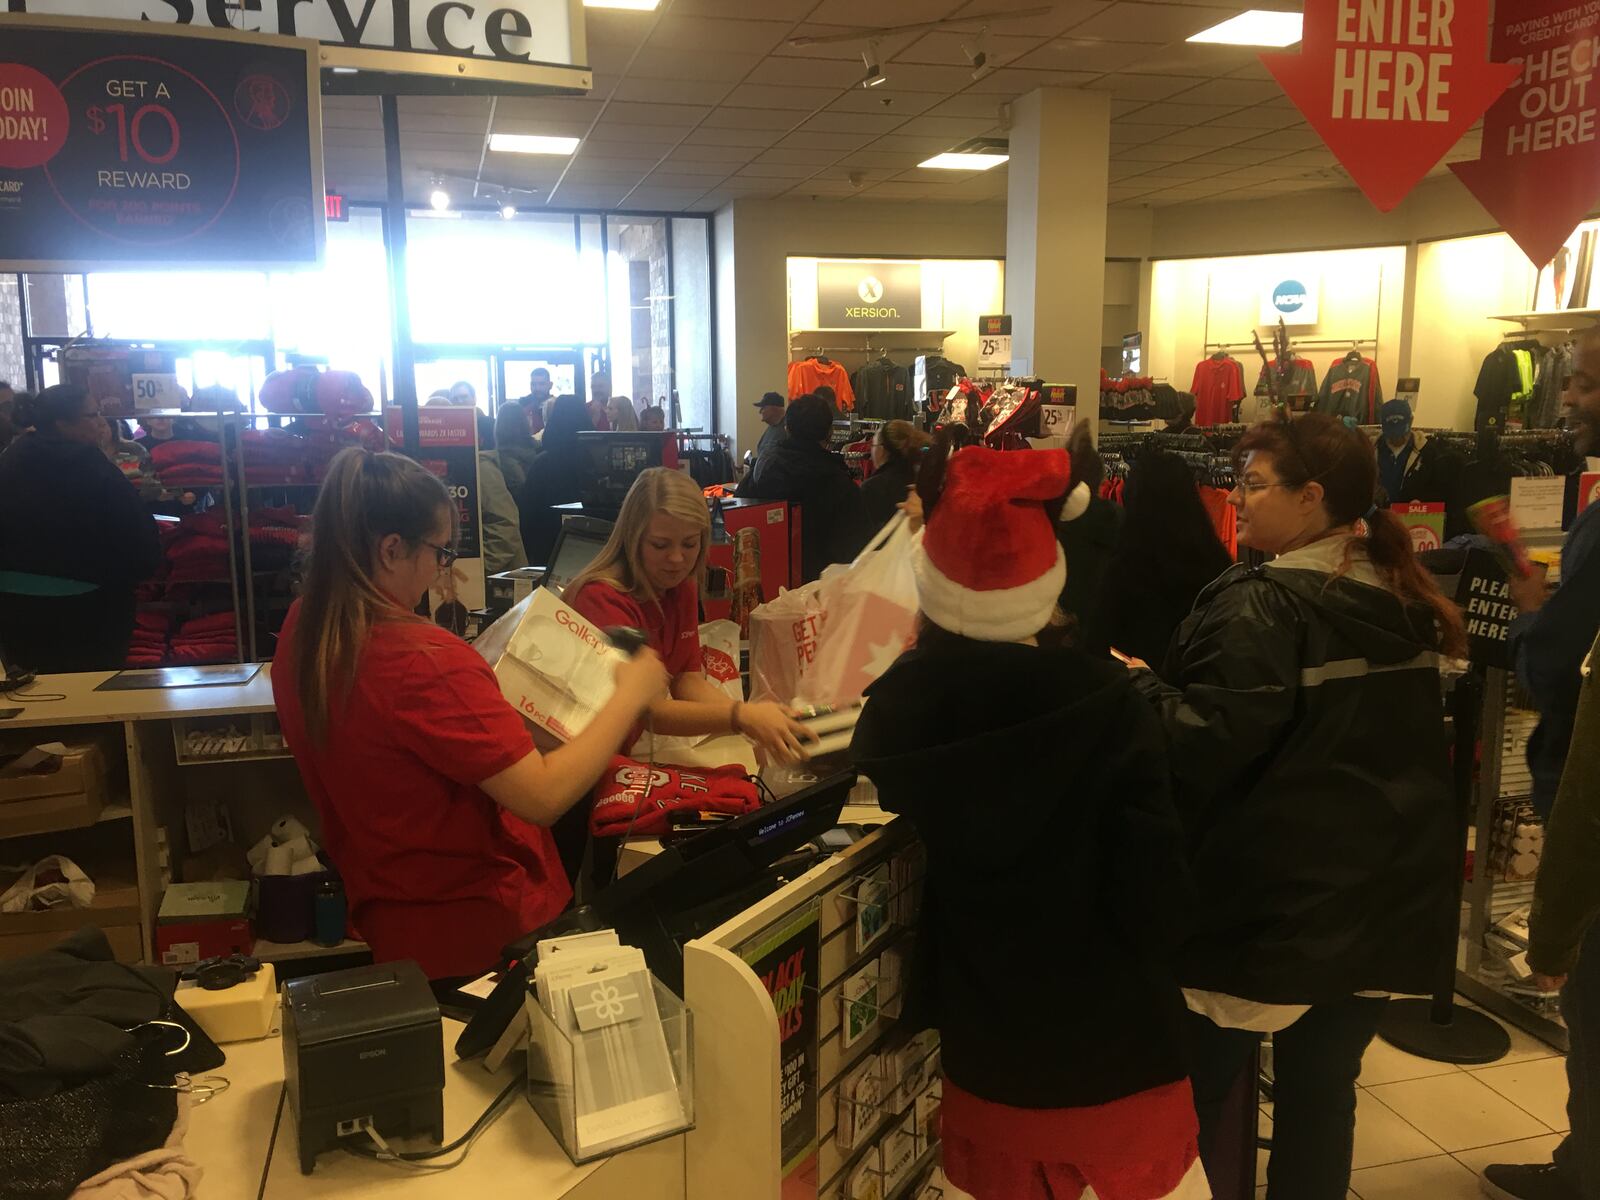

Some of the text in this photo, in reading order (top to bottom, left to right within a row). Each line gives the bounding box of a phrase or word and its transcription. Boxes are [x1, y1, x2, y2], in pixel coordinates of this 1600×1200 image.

[1336, 0, 1454, 47] ENTER
[1506, 1, 1600, 36] PAYING WITH YO
[1520, 25, 1563, 45] CREDIT
[106, 79, 171, 99] GET A
[1332, 48, 1453, 122] HERE
[1519, 74, 1592, 119] OUT
[0, 87, 34, 113] OIN
[86, 103, 180, 165] $10
[1506, 108, 1597, 156] HERE
[98, 170, 191, 190] REWARD
[1409, 505, 1428, 513] SALE
[1470, 577, 1509, 599] PLEA
[1468, 597, 1519, 620] ENTER
[555, 609, 607, 656] Gallery
[792, 615, 816, 642] GET
[1468, 619, 1509, 641] HERE
[519, 695, 535, 713] 16
[359, 1047, 387, 1060] EPSON
[781, 1097, 802, 1125] OUPON
